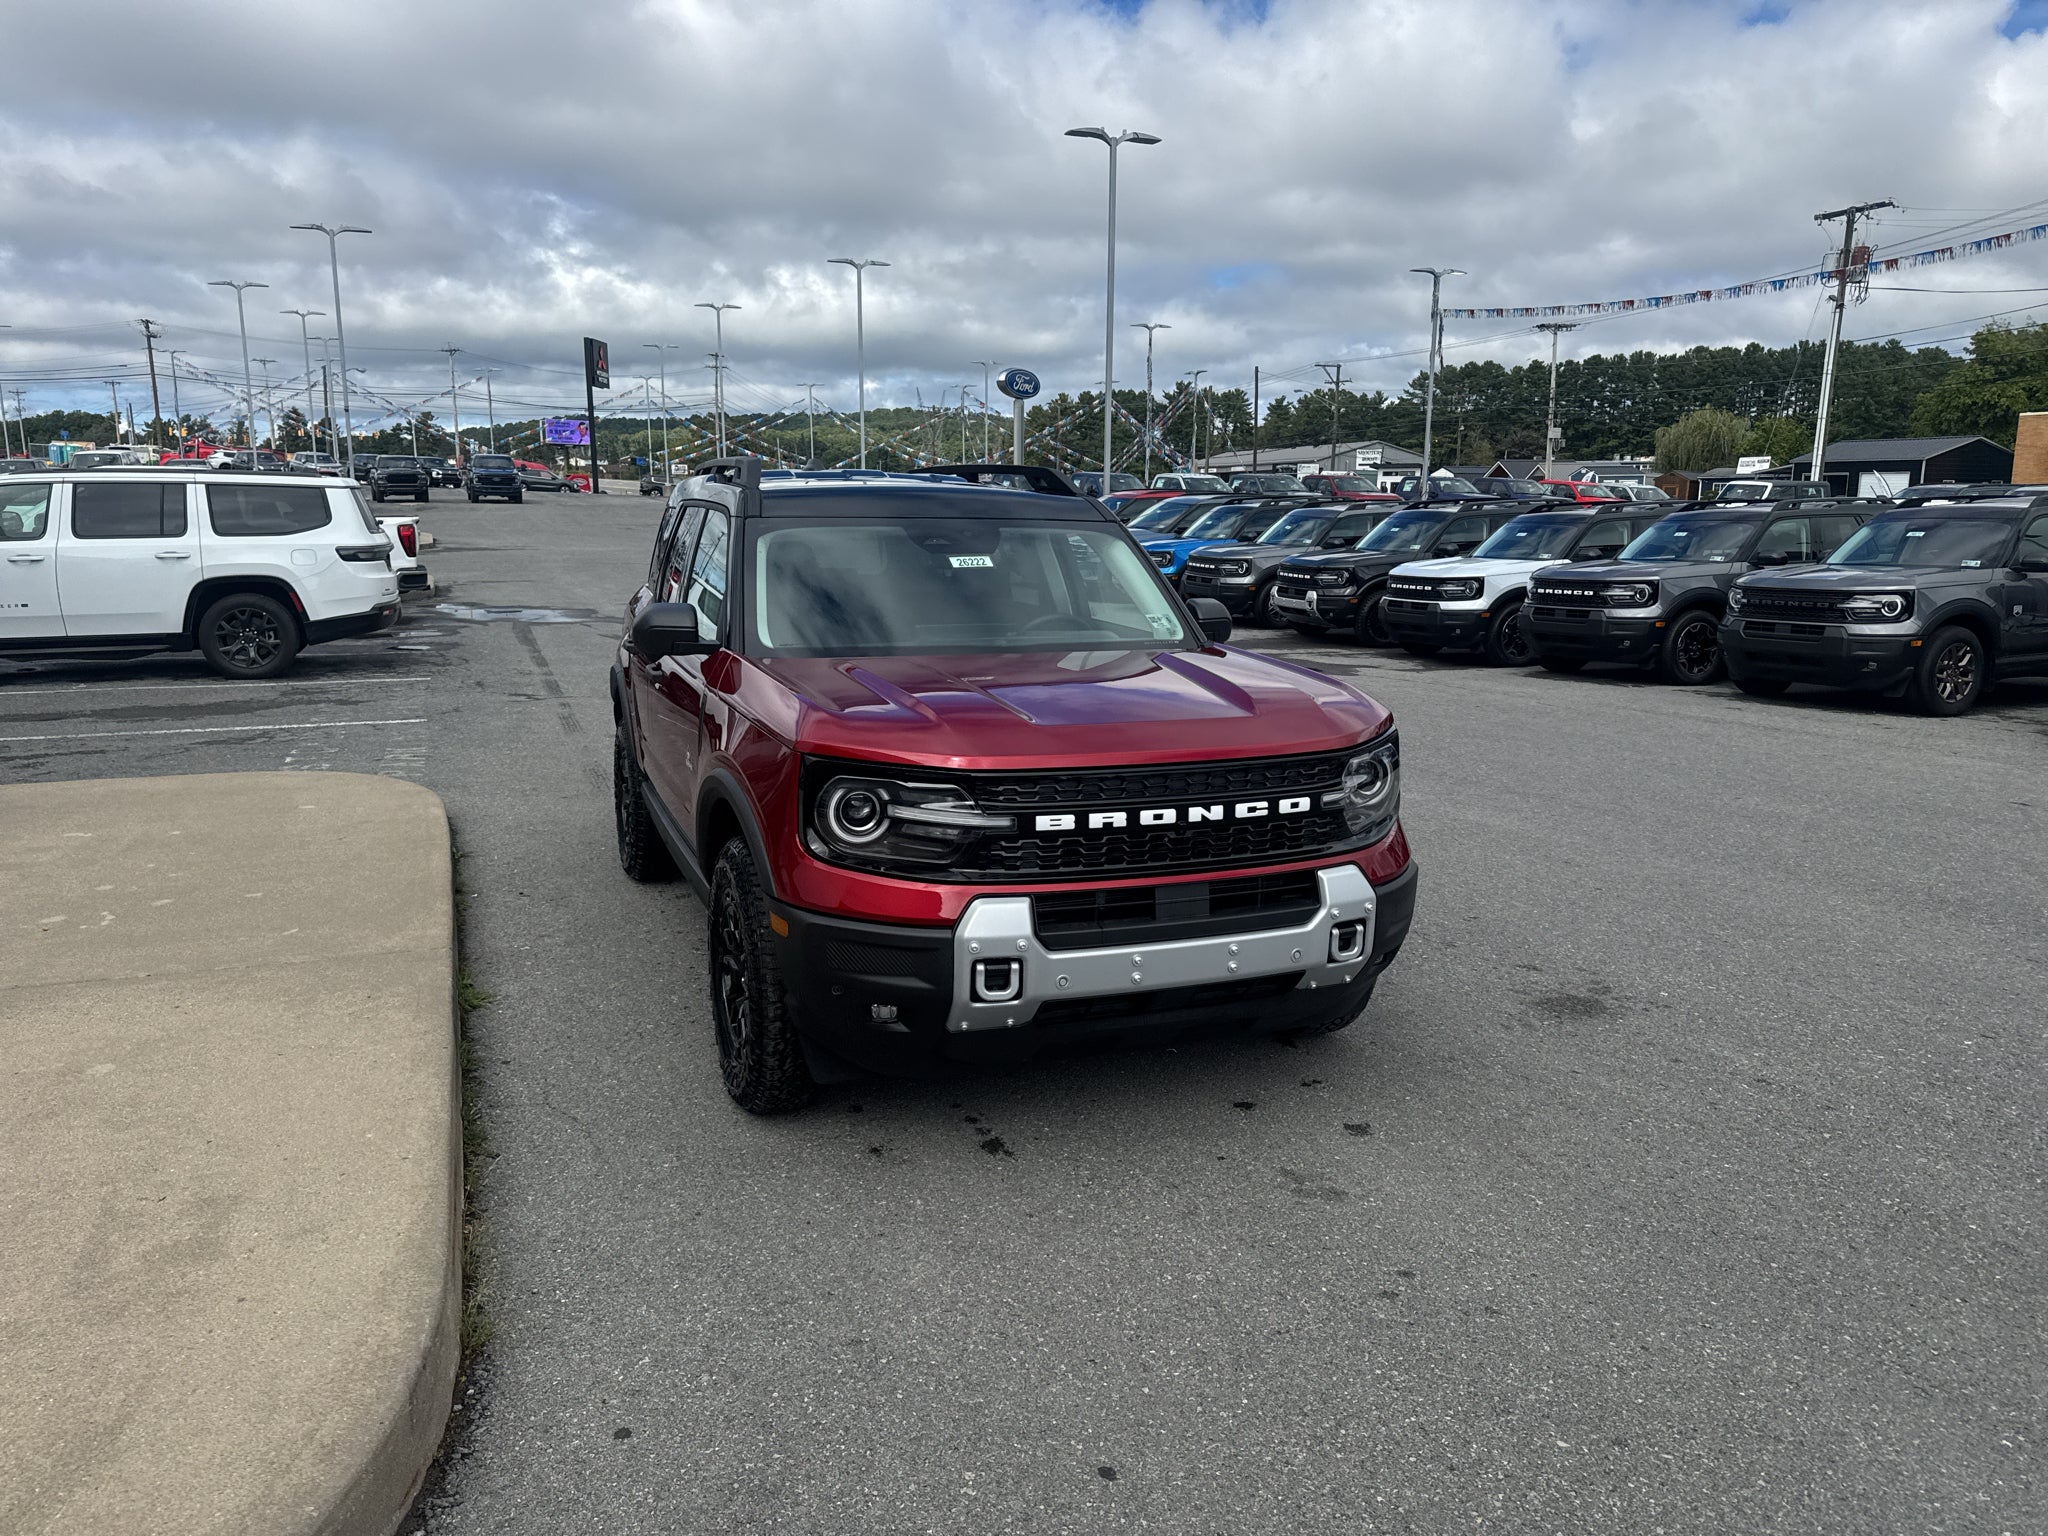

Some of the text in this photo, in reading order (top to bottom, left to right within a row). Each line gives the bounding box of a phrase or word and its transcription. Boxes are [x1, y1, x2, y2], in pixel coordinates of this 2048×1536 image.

[1013, 374, 1034, 392] Ford
[956, 557, 988, 567] 26222
[1279, 571, 1310, 579] BRONCO
[1391, 583, 1432, 591] BRONCO
[1537, 588, 1594, 596] BRONCO
[1035, 796, 1311, 832] BRONCO
